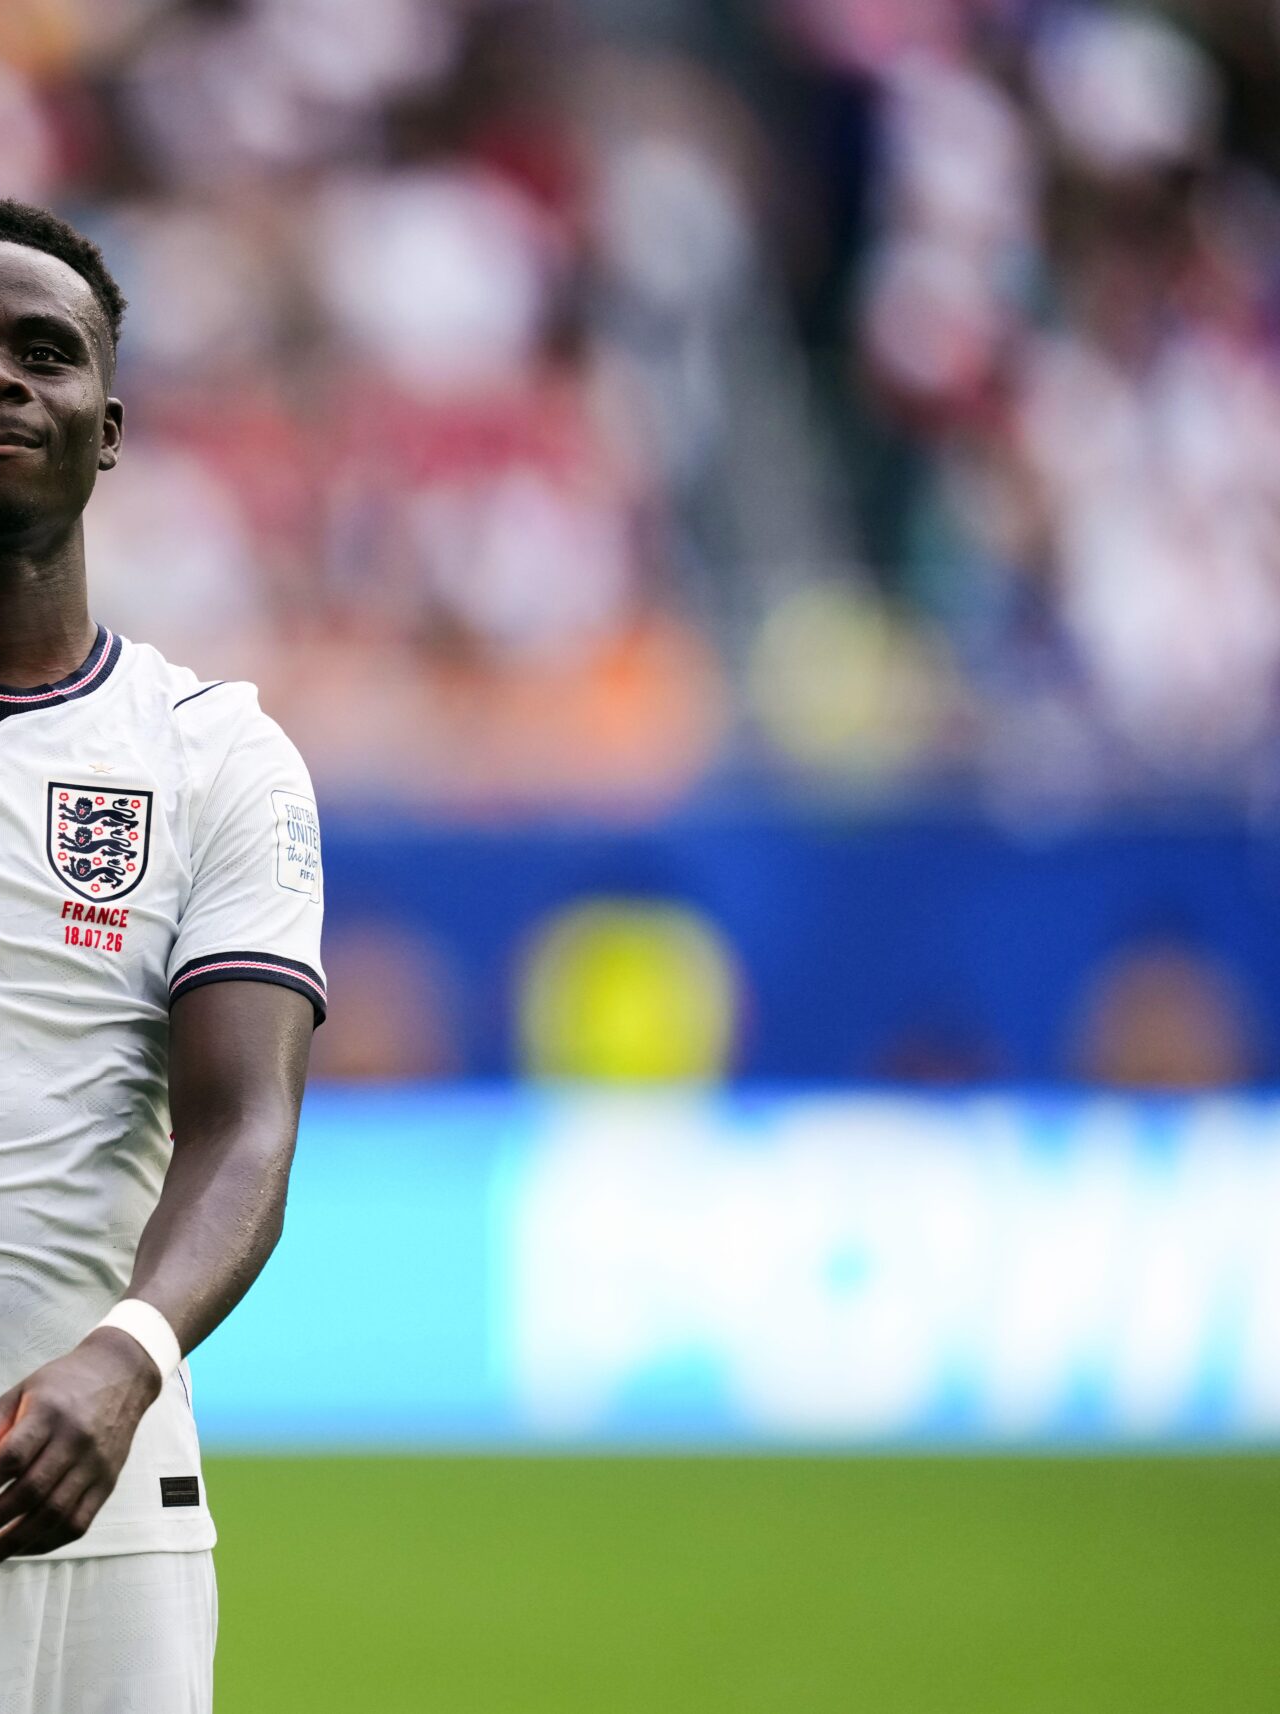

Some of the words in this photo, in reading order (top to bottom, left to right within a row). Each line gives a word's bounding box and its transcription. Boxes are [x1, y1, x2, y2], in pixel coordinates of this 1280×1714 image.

[285, 804, 318, 830] FOOTBA
[285, 844, 303, 862] the
[61, 901, 129, 928] FRANCE
[65, 925, 123, 952] 18.07.26
